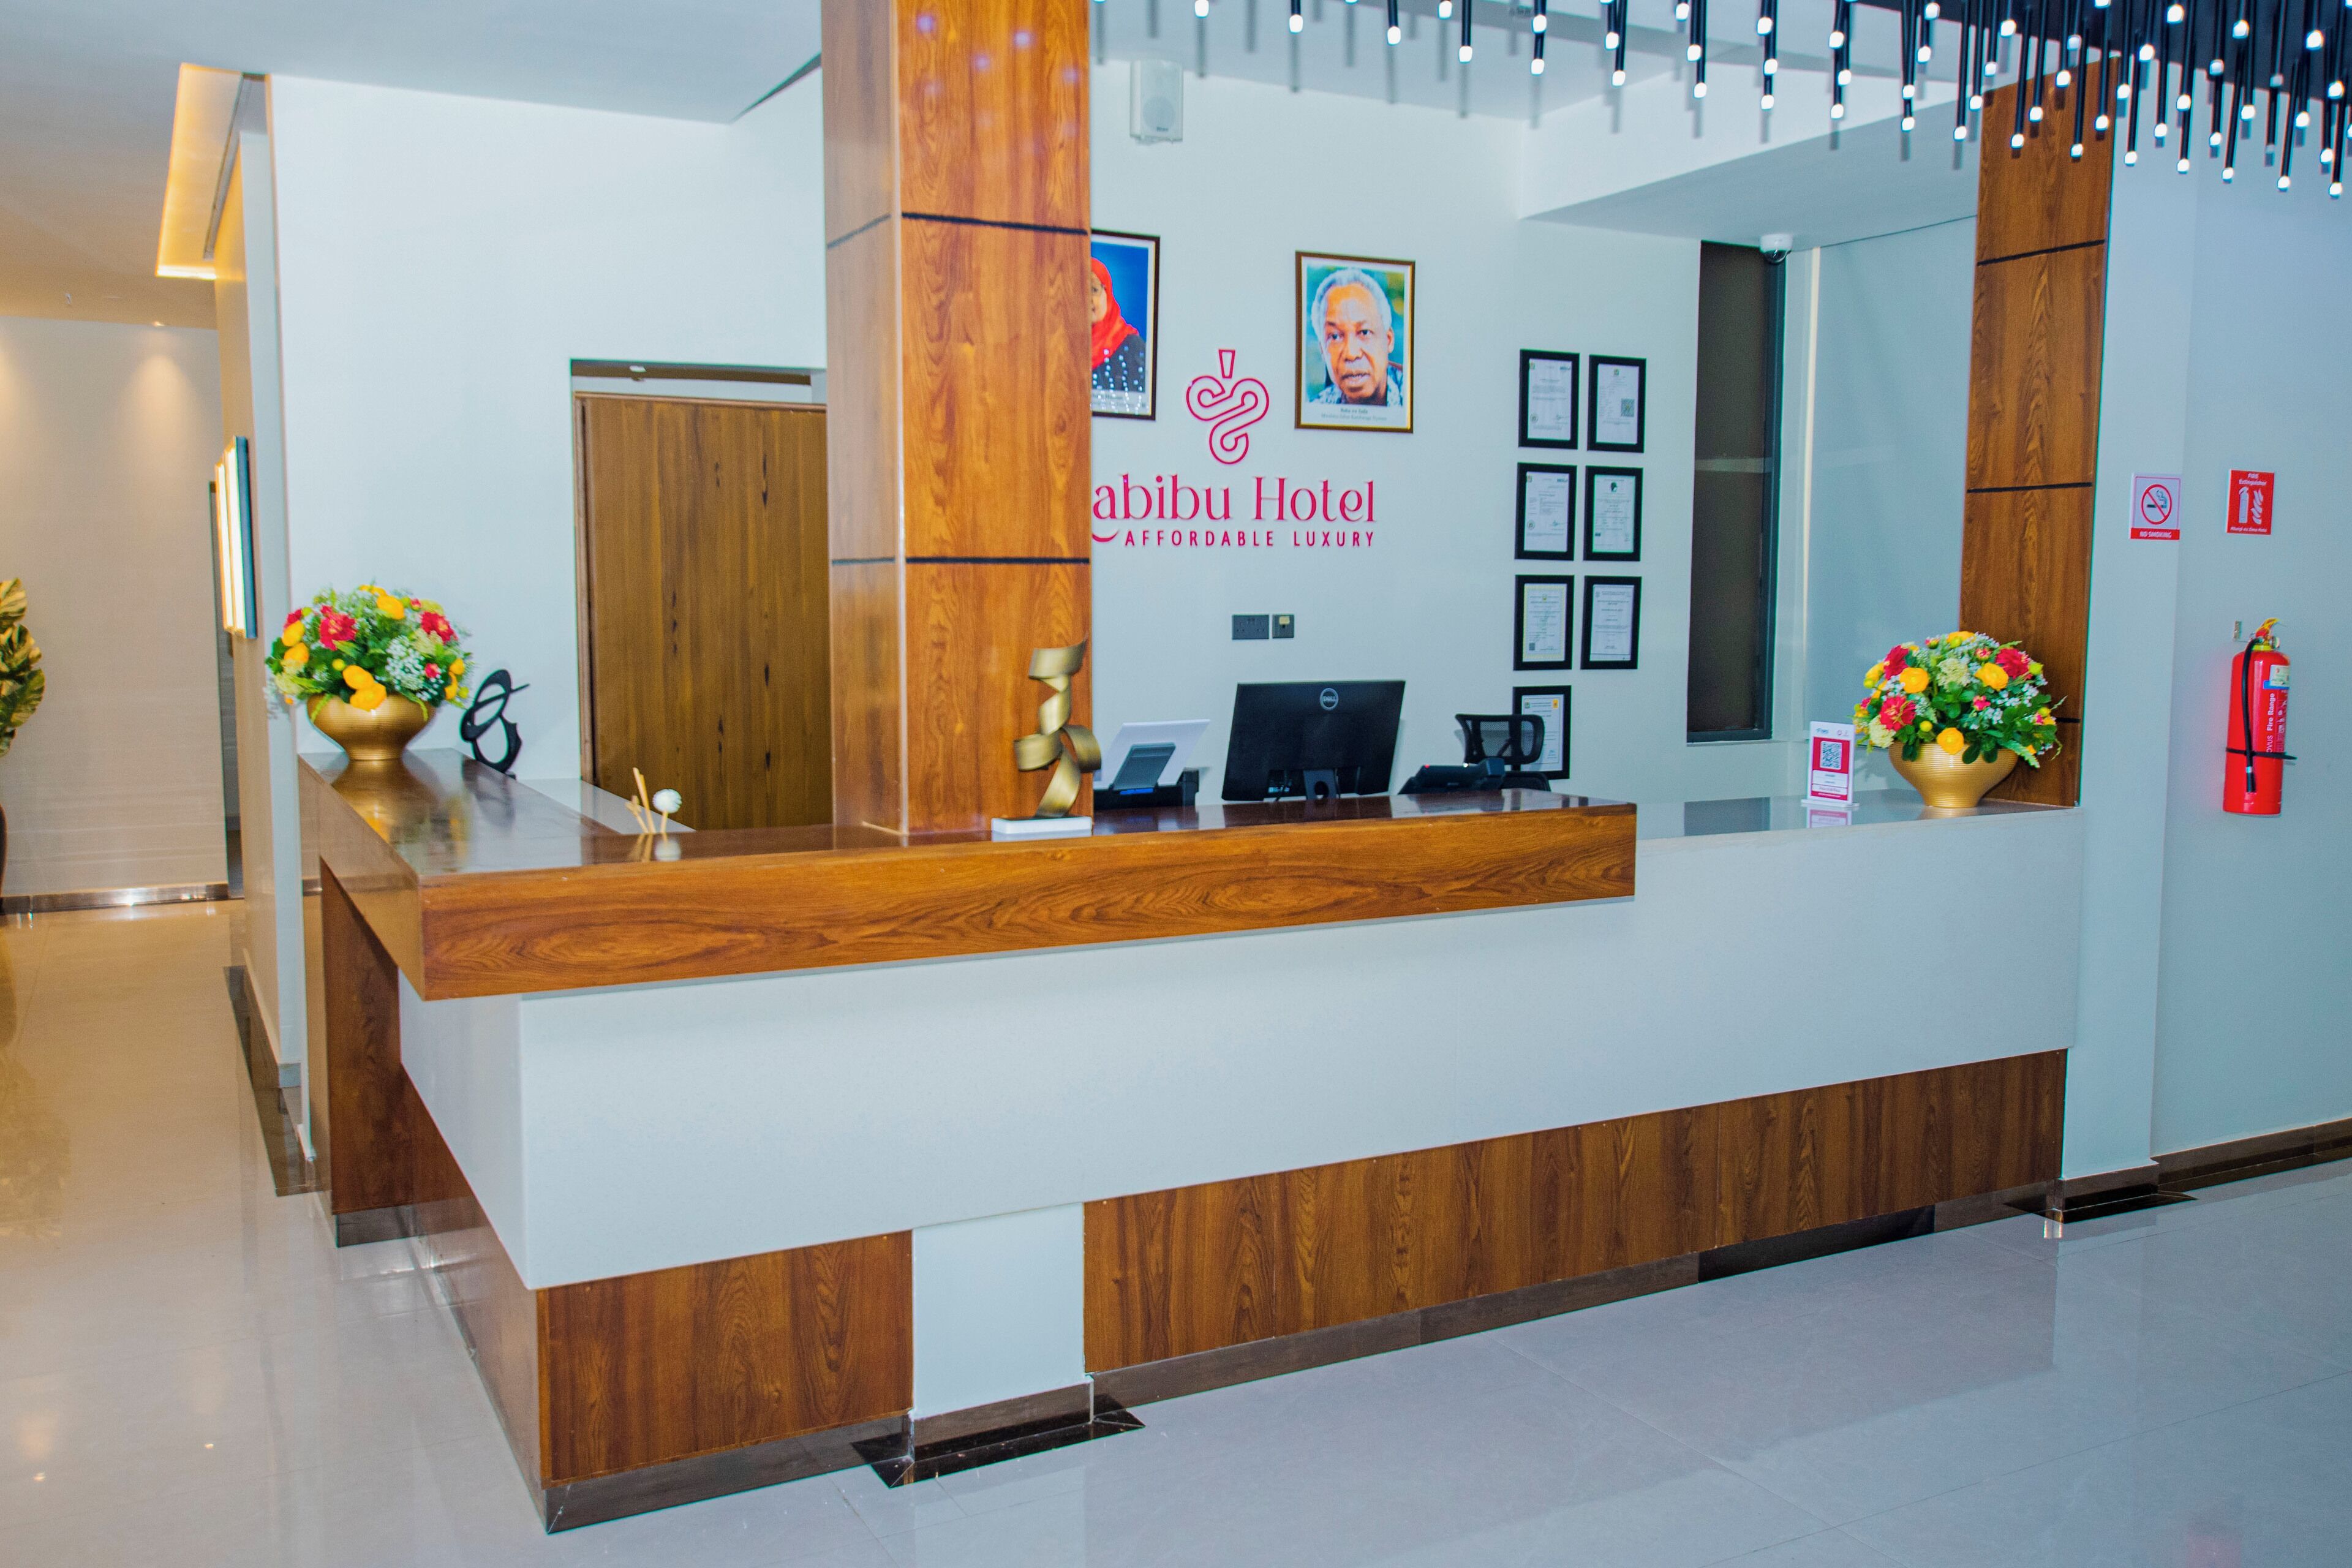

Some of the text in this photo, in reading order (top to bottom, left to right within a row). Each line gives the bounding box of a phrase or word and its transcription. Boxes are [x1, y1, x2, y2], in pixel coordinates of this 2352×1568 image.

[1092, 473, 1376, 522] abibu Hotel
[1125, 530, 1374, 548] AFFORDABLE LUXURY
[2267, 693, 2276, 715] Range
